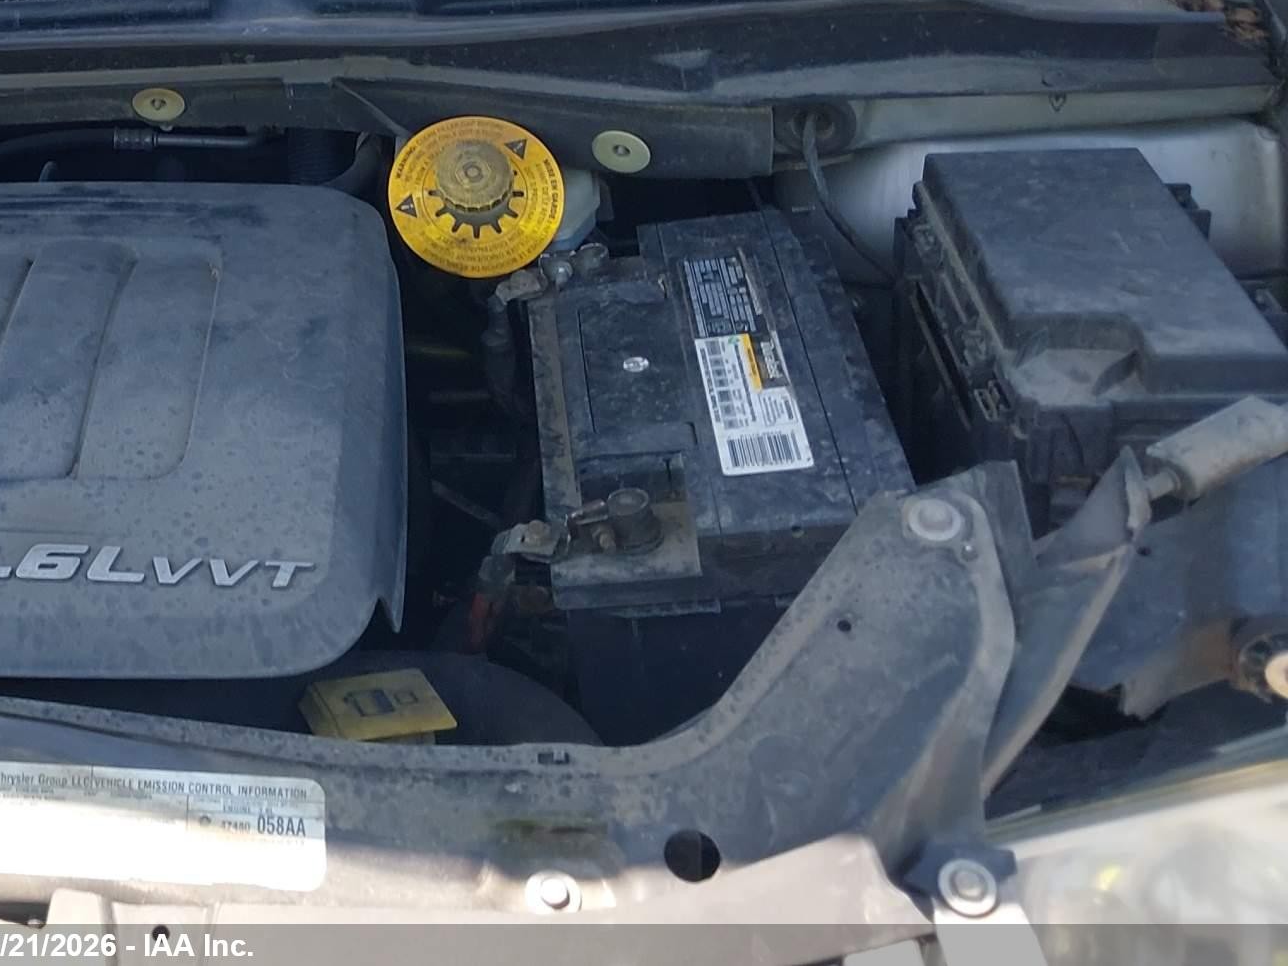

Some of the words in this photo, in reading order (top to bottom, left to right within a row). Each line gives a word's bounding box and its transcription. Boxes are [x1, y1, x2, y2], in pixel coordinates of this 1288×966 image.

[38, 773, 69, 789] Group
[137, 778, 185, 793] EMISSION
[188, 782, 234, 795] CONTROL
[238, 785, 307, 800] INFORMATION
[257, 813, 306, 838] 058AA
